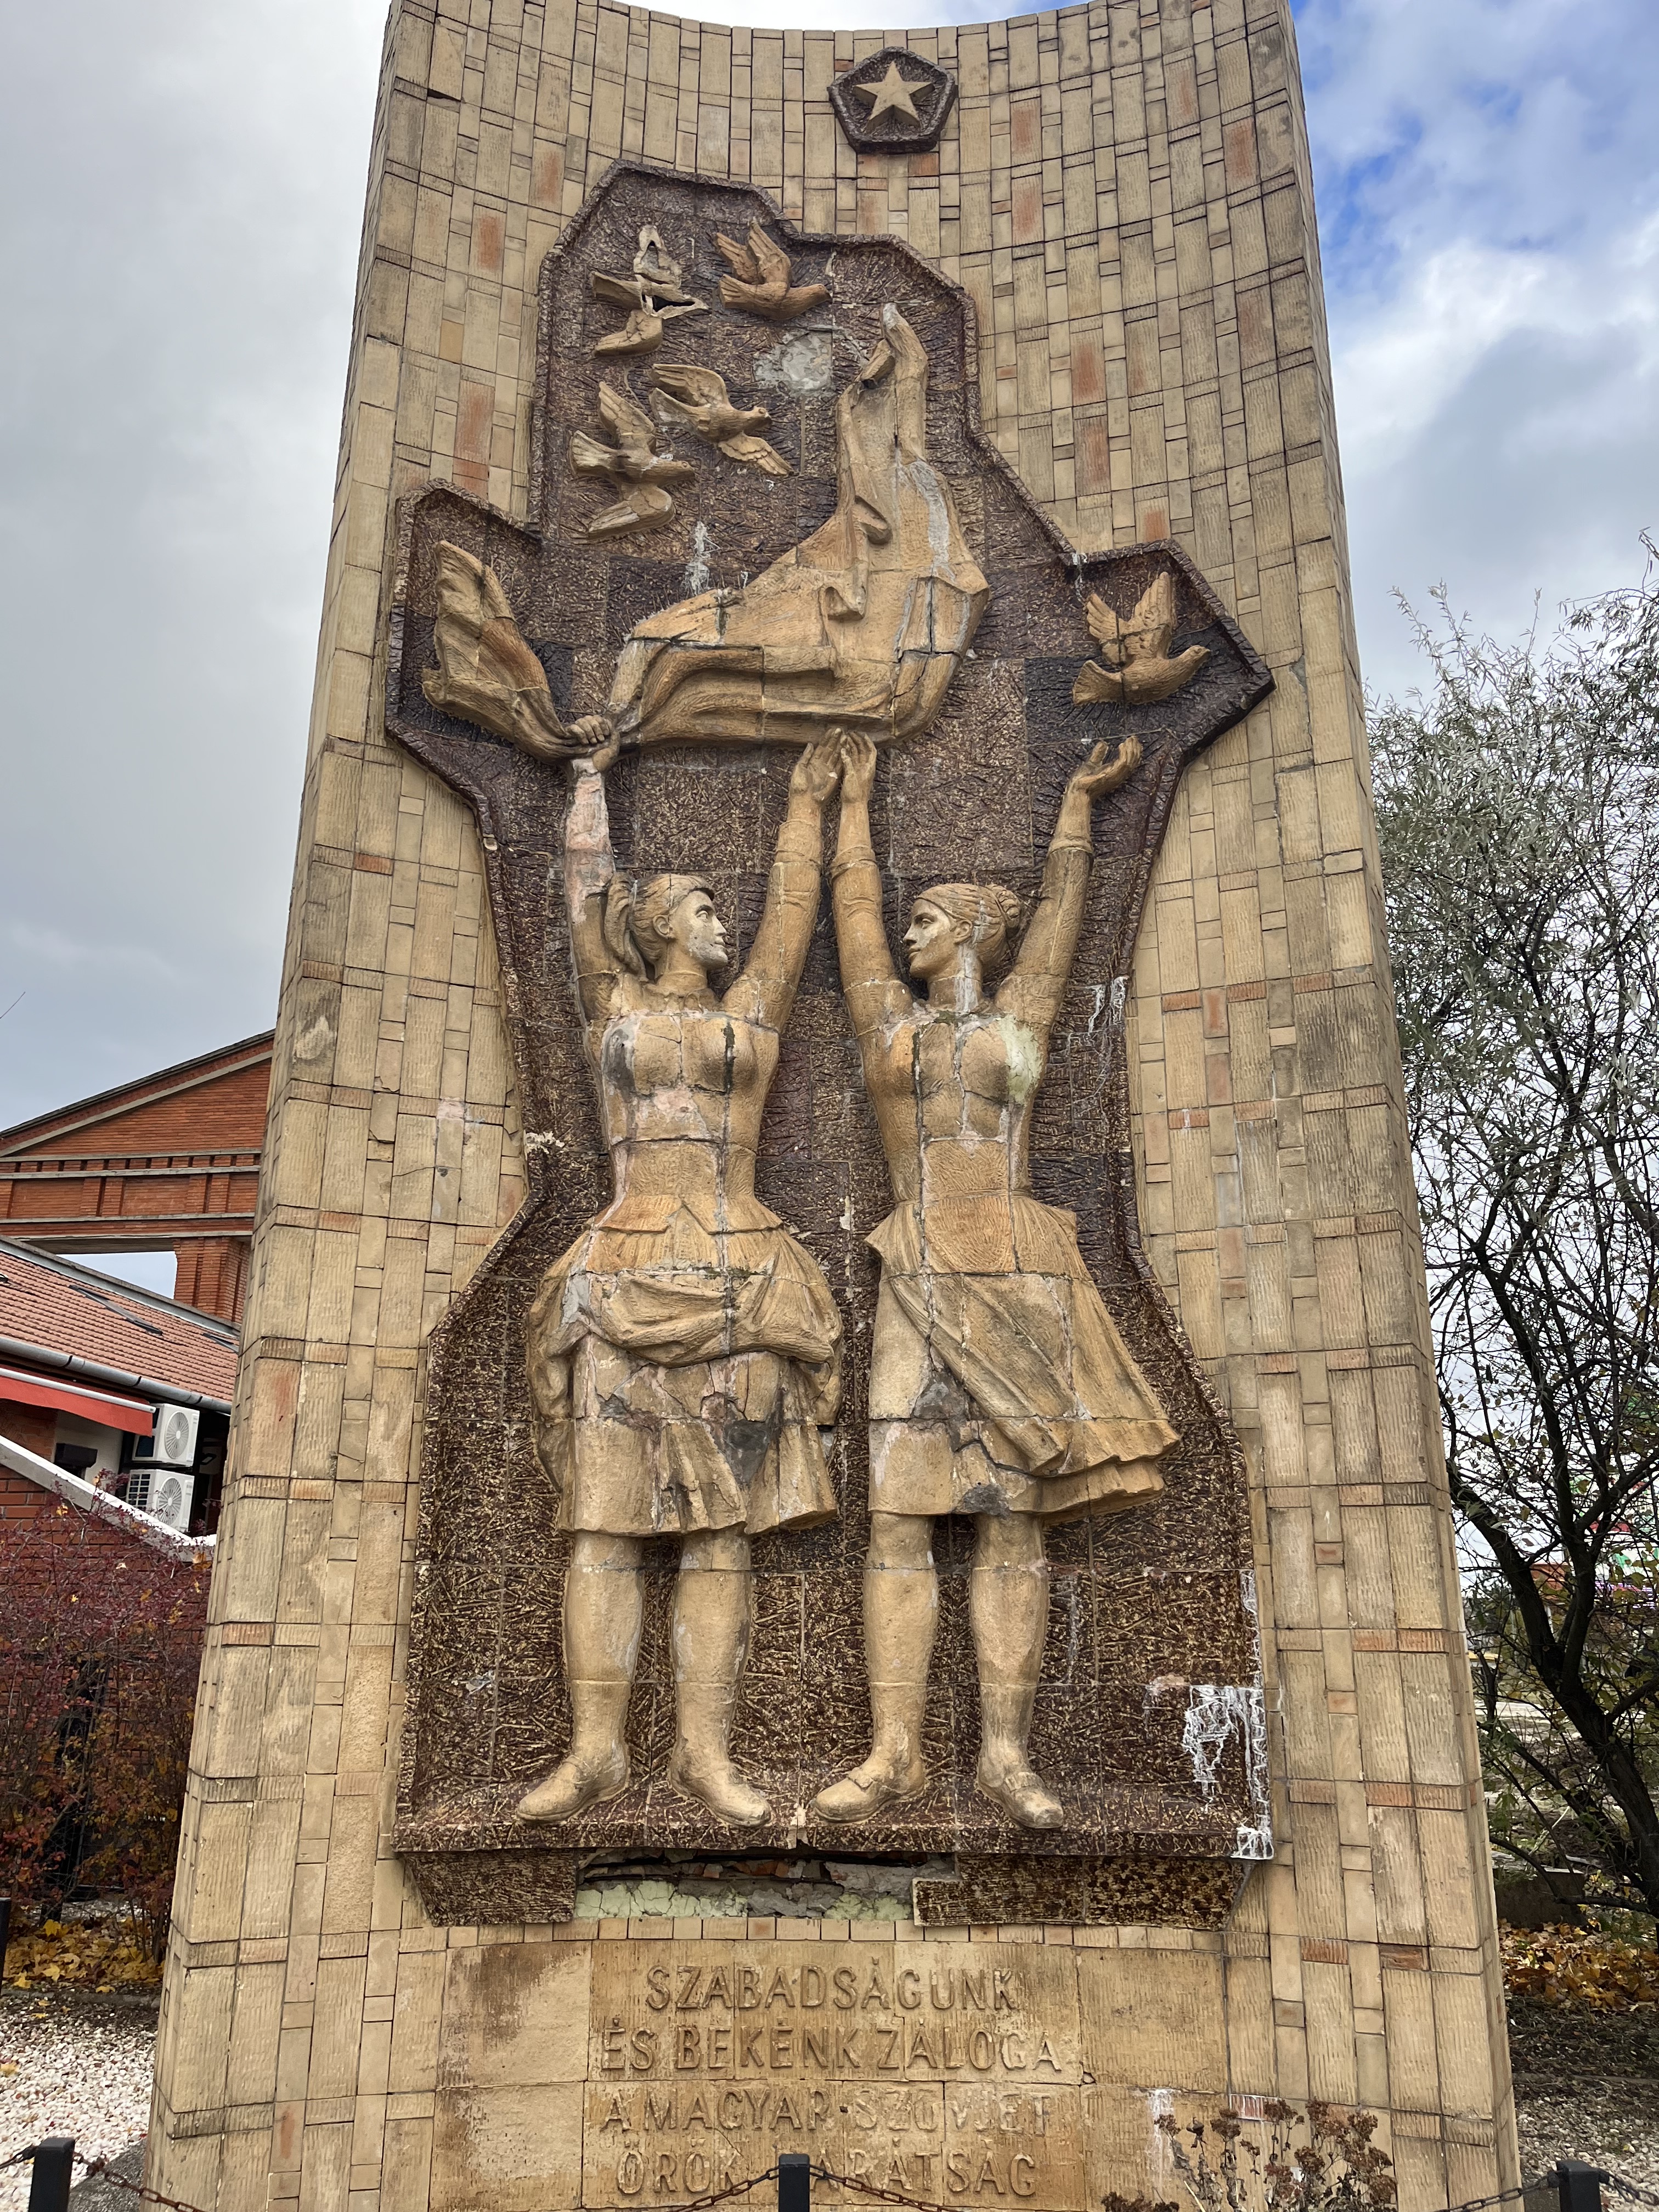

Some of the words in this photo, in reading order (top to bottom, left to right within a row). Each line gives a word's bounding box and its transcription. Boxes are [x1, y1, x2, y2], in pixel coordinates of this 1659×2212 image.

[645, 1956, 1018, 2010] SZABADSÁGUNK
[602, 2017, 658, 2070] ÉS
[877, 2017, 1062, 2072] ZÁLOGA
[600, 2089, 633, 2131] A
[774, 2136, 1036, 2196] ARÁTSÁG
